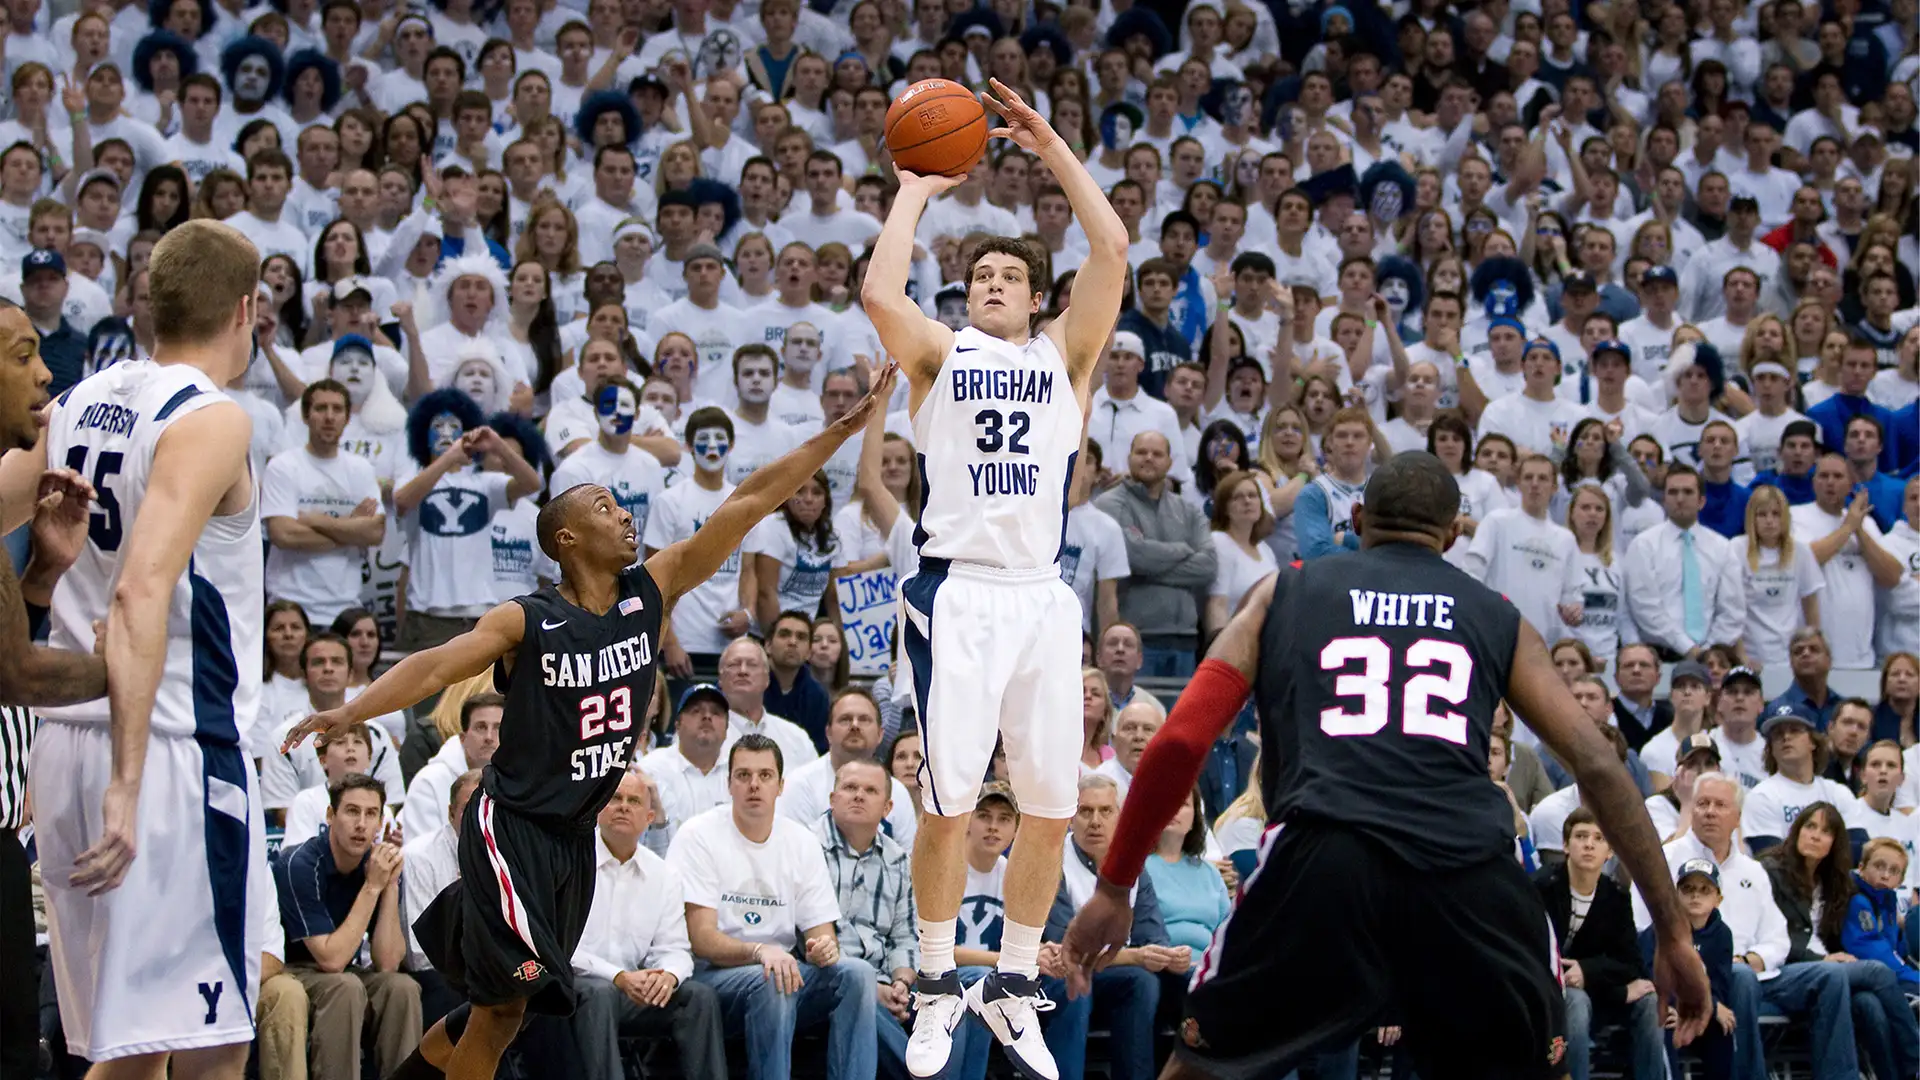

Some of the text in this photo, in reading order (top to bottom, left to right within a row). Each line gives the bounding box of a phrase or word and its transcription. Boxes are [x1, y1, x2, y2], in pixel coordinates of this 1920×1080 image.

[952, 369, 1053, 404] BRIGHAM
[975, 409, 1031, 455] 32
[967, 462, 1040, 497] YOUNG
[1349, 588, 1455, 631] WHITE
[541, 631, 652, 688] SAN DIEGO
[1320, 634, 1474, 747] 32
[580, 685, 633, 741] 23
[198, 981, 223, 1024] Y
